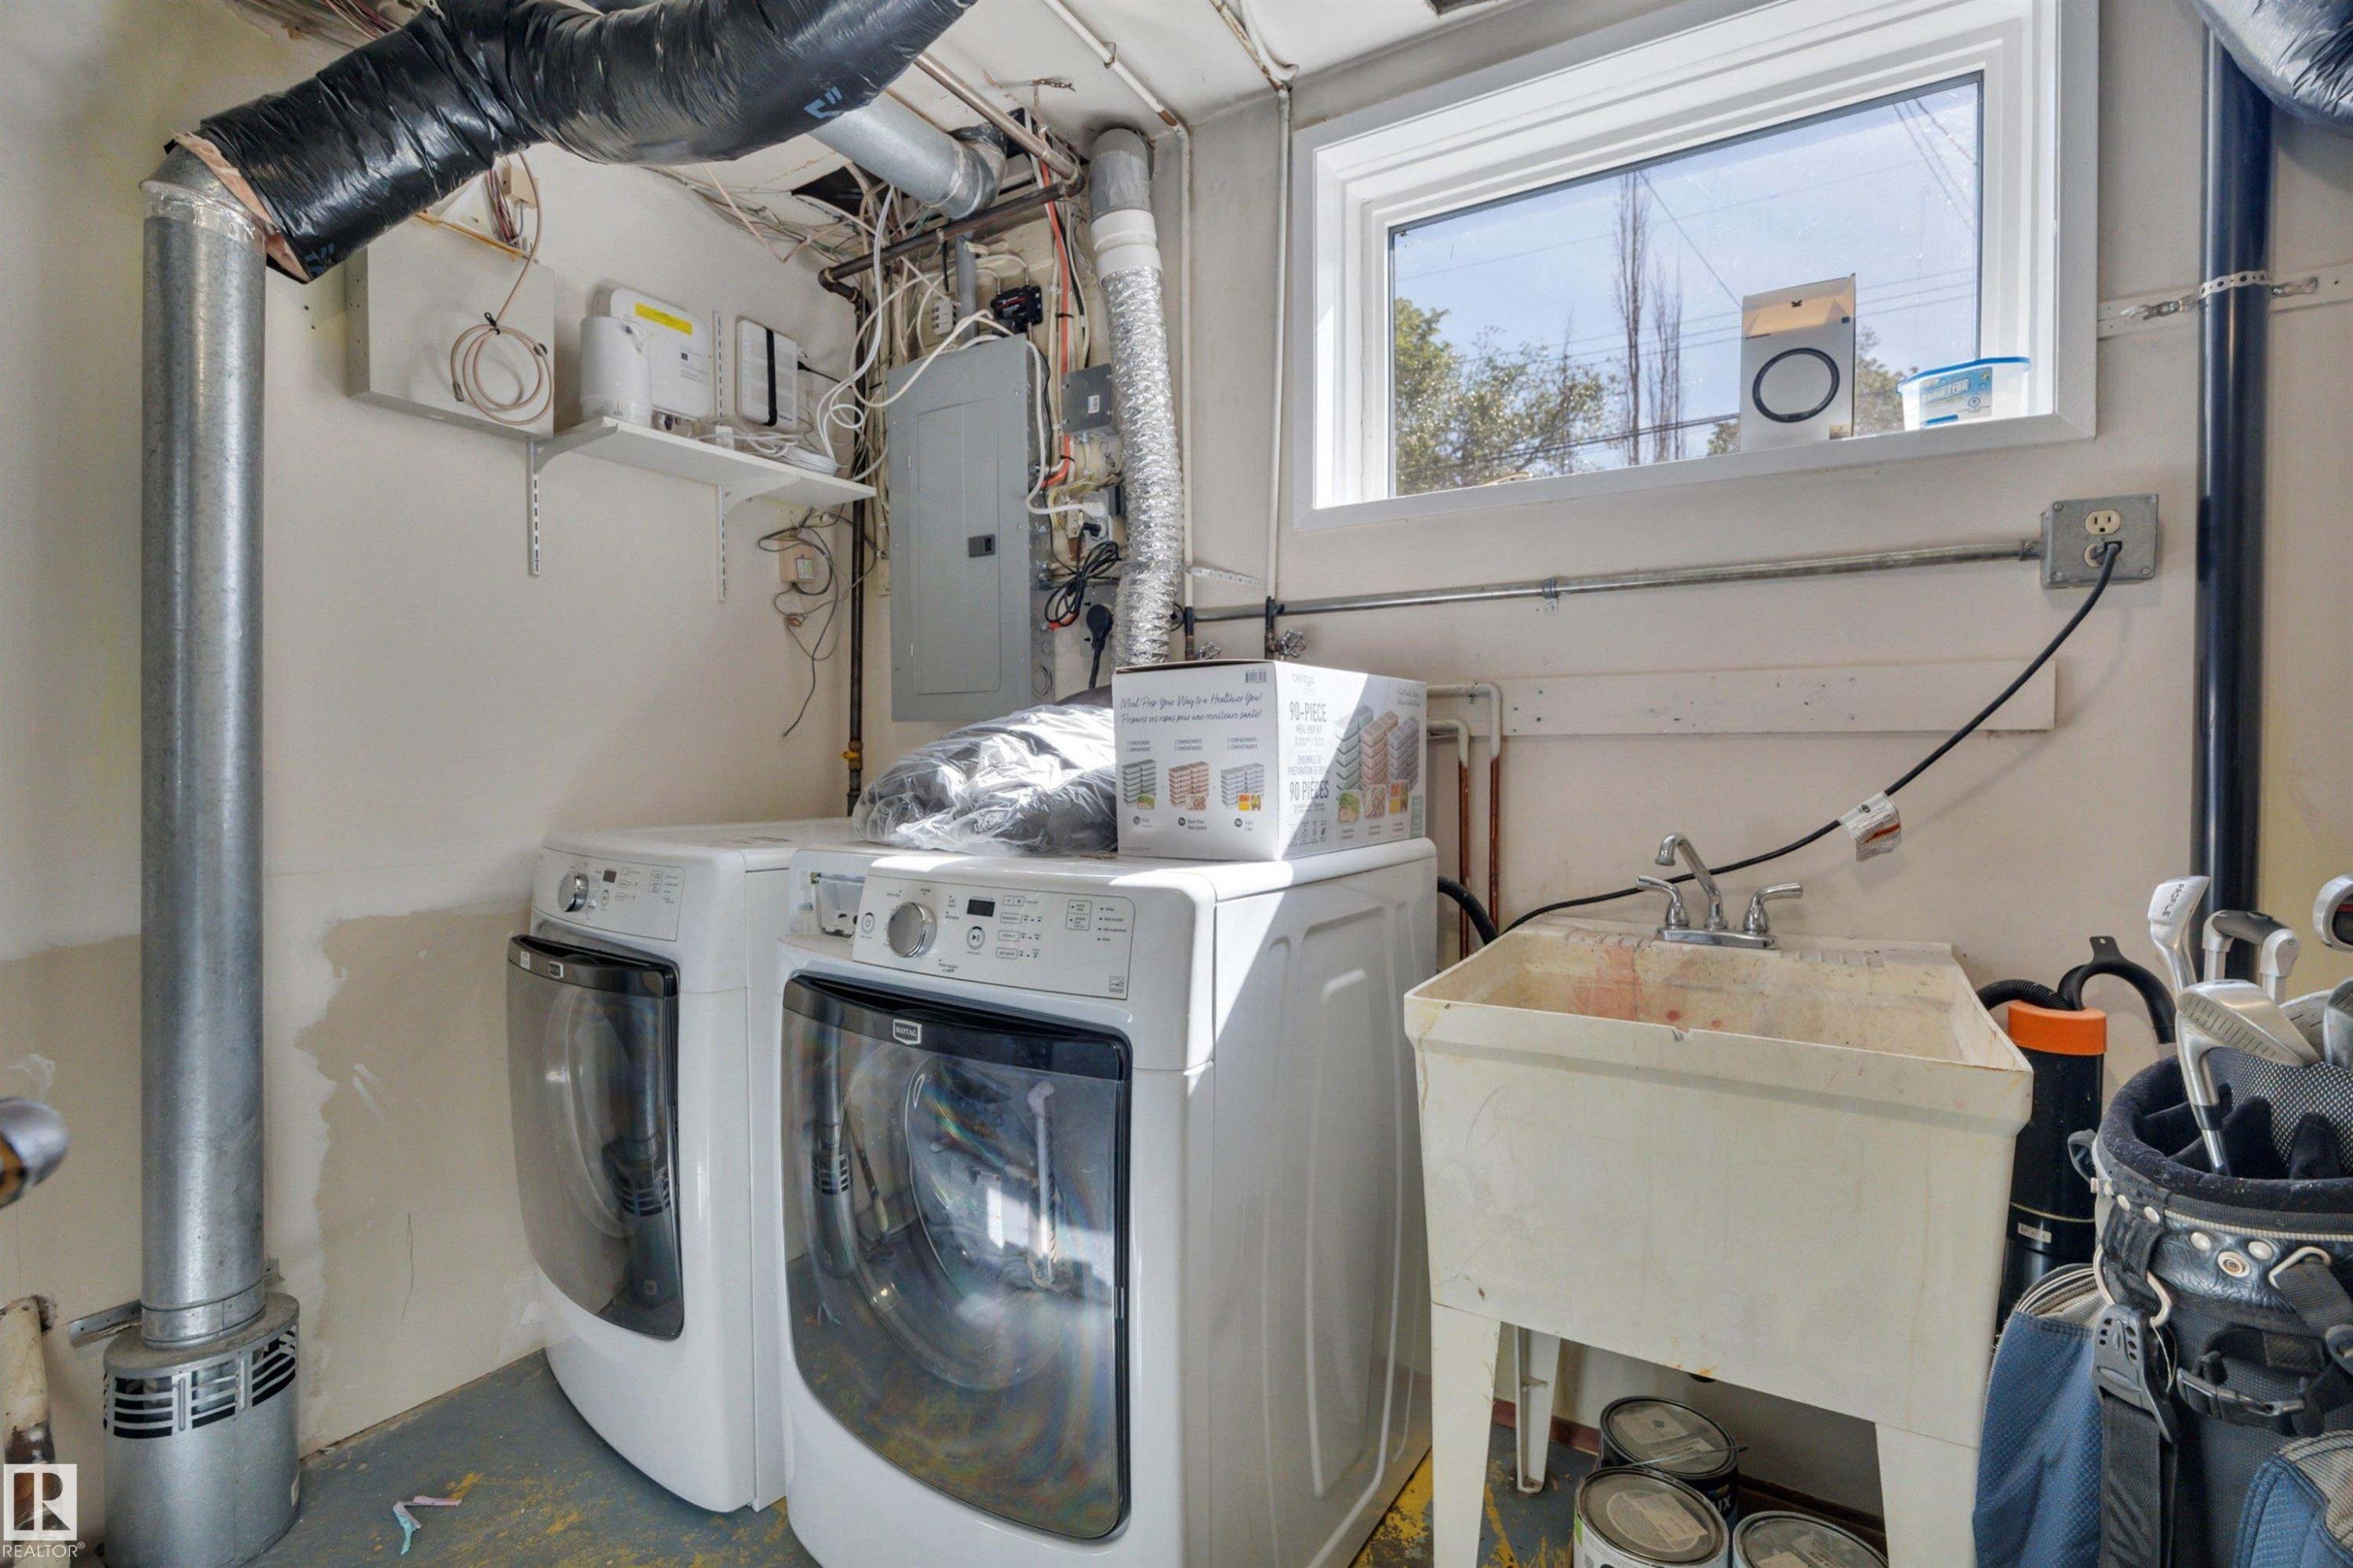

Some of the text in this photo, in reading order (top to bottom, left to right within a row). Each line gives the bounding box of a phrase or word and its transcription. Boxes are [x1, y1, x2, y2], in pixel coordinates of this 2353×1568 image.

[1120, 697, 1138, 710] Meal
[1177, 695, 1195, 708] Way
[1210, 692, 1243, 705] Healthier
[1289, 700, 1326, 722] 90-PIECE
[1289, 777, 1329, 801] 90 PIÈCES
[2162, 883, 2184, 917] PROFILE
[896, 1026, 917, 1036] MAYTAG
